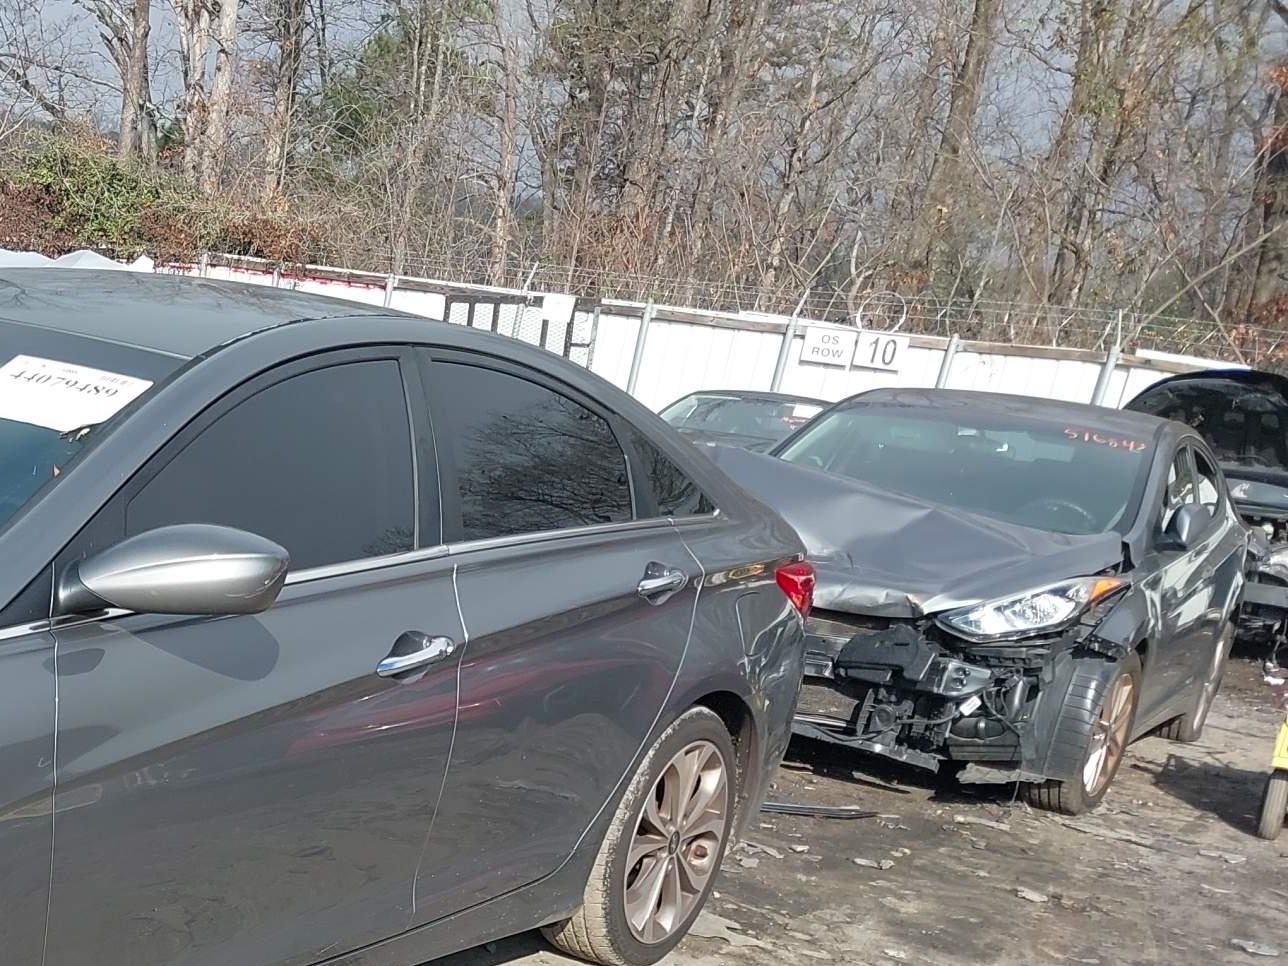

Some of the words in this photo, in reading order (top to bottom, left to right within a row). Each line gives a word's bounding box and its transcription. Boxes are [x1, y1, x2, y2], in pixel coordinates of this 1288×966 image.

[821, 334, 840, 345] OS
[812, 346, 843, 358] ROW
[870, 337, 897, 366] 10
[10, 369, 119, 398] 44079489
